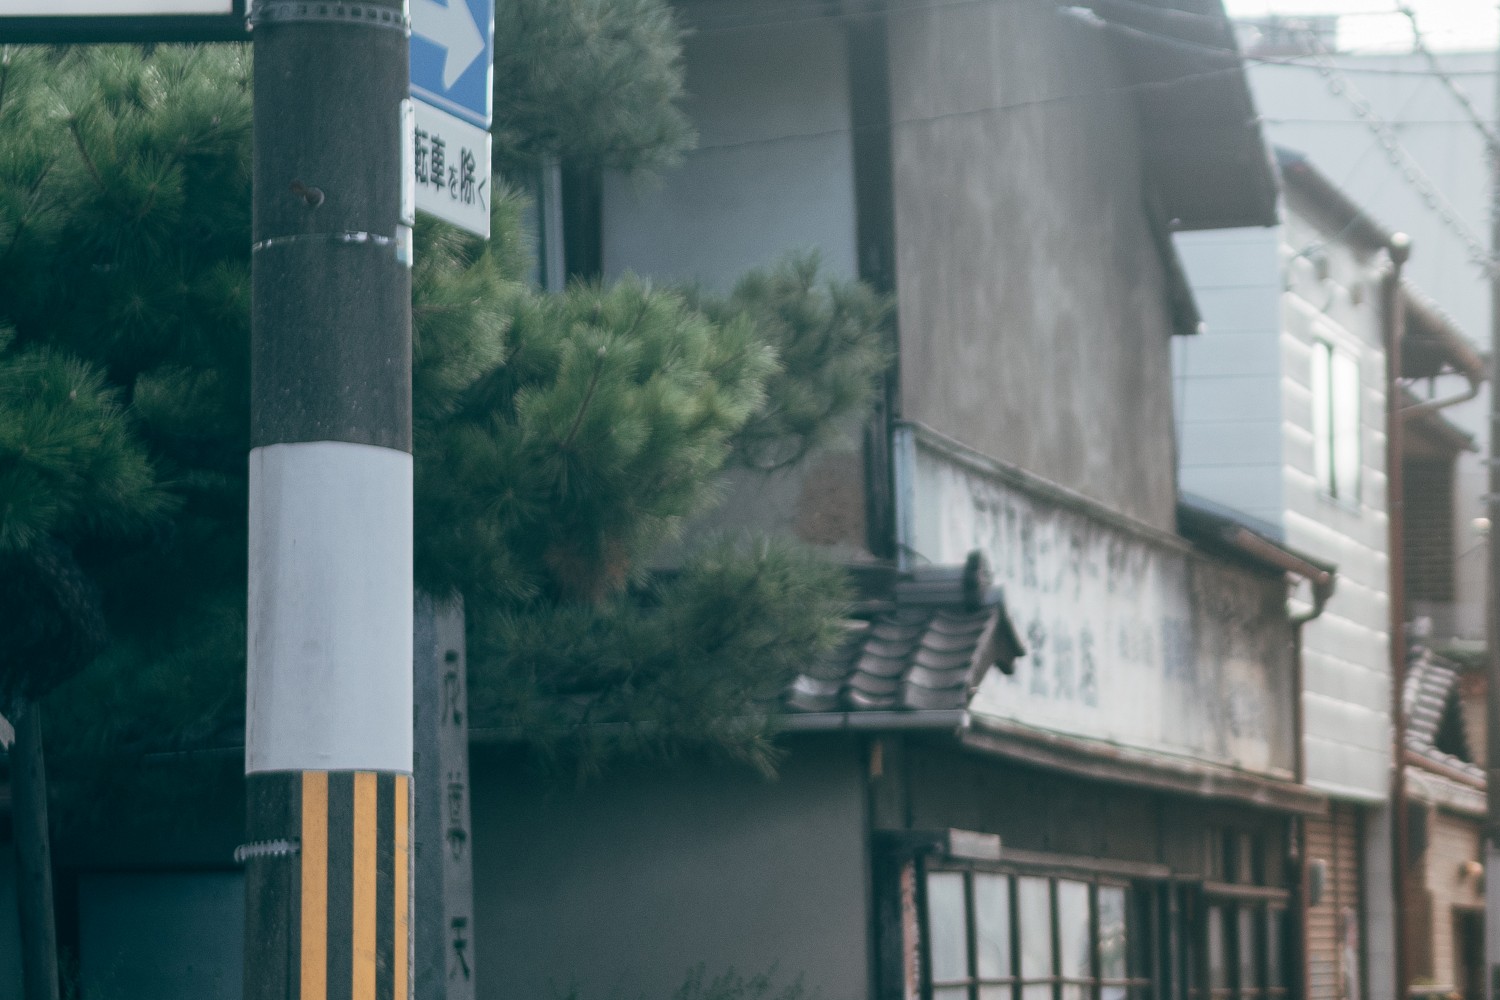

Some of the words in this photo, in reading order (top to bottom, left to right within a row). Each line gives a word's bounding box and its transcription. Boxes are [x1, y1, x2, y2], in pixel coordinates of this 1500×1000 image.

[414, 126, 486, 212] 転車を除く
